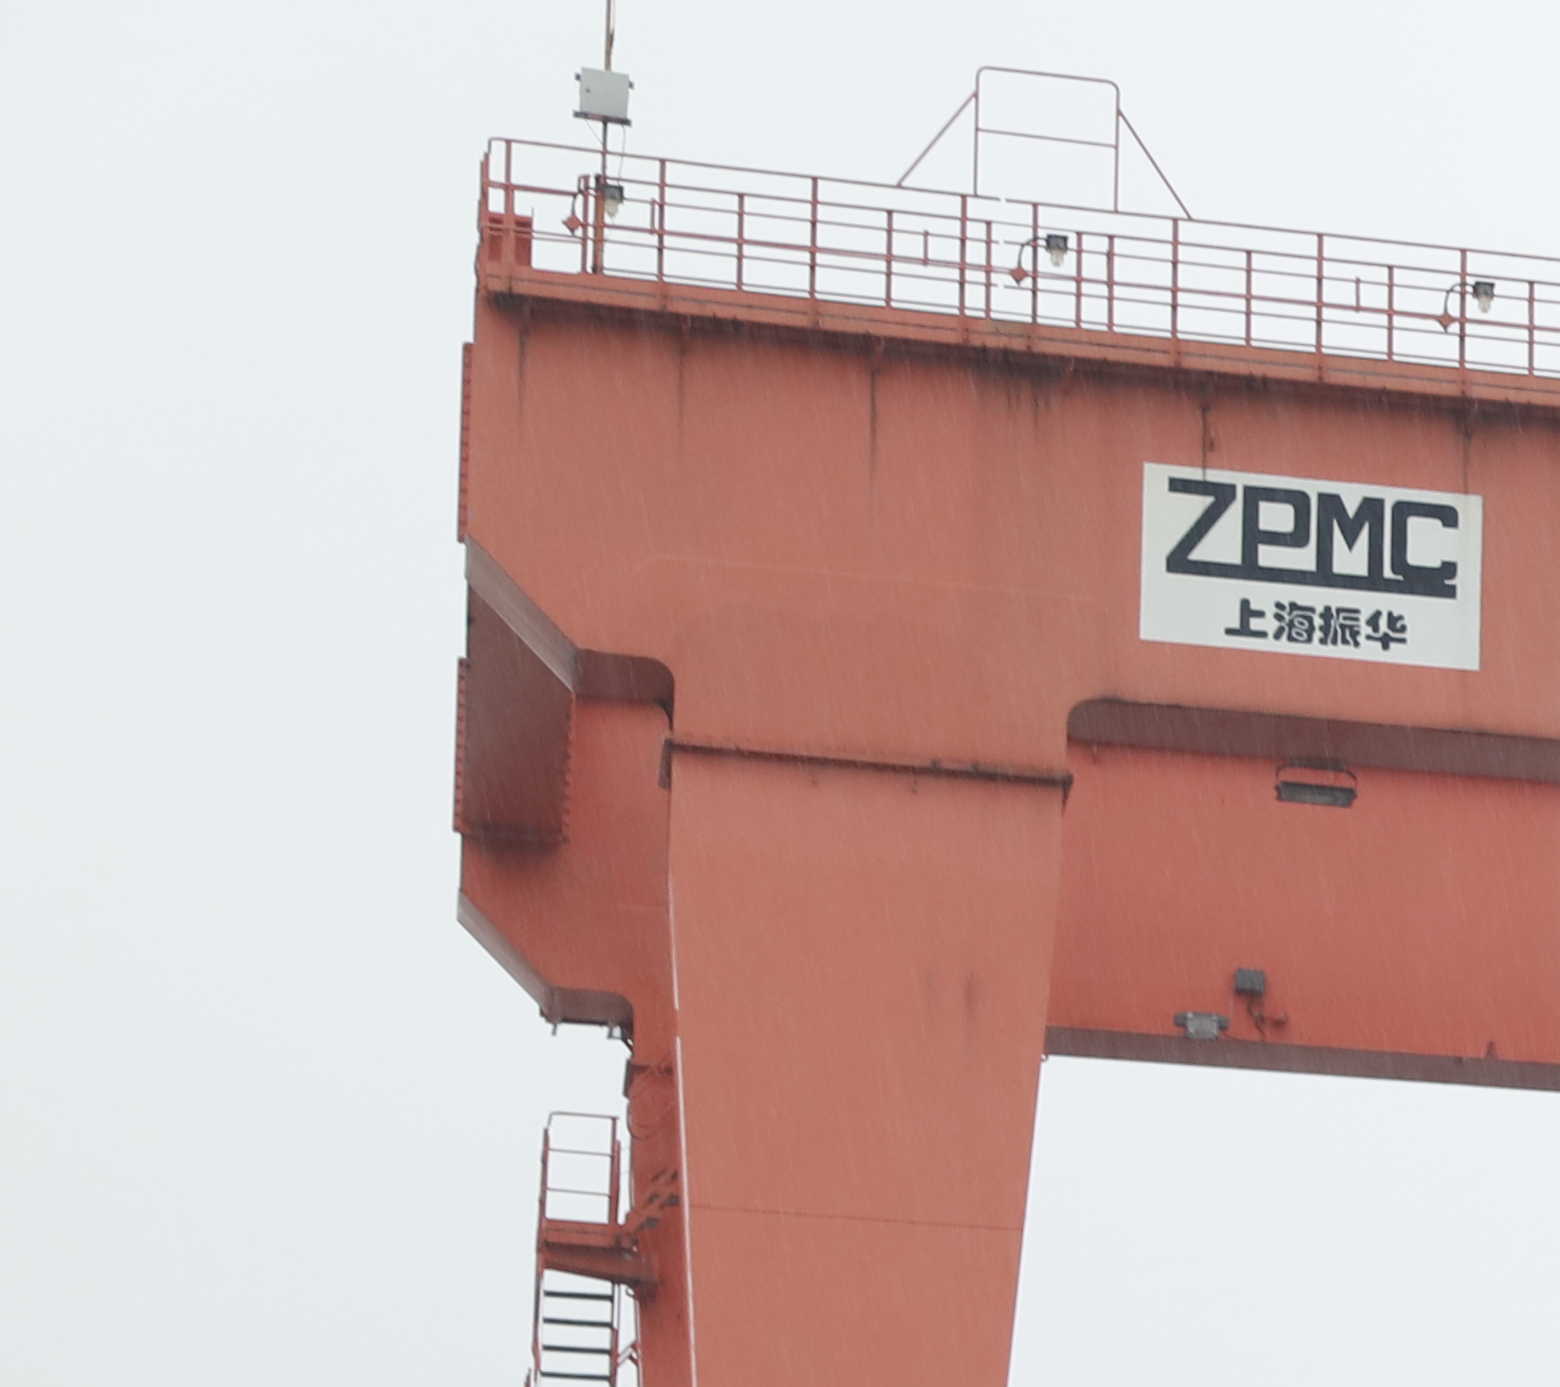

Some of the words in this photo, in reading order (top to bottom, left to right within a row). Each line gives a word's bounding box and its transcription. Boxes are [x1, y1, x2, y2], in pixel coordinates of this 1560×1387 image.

[1166, 476, 1458, 600] ZPMC
[1225, 598, 1407, 651] 上海振华
